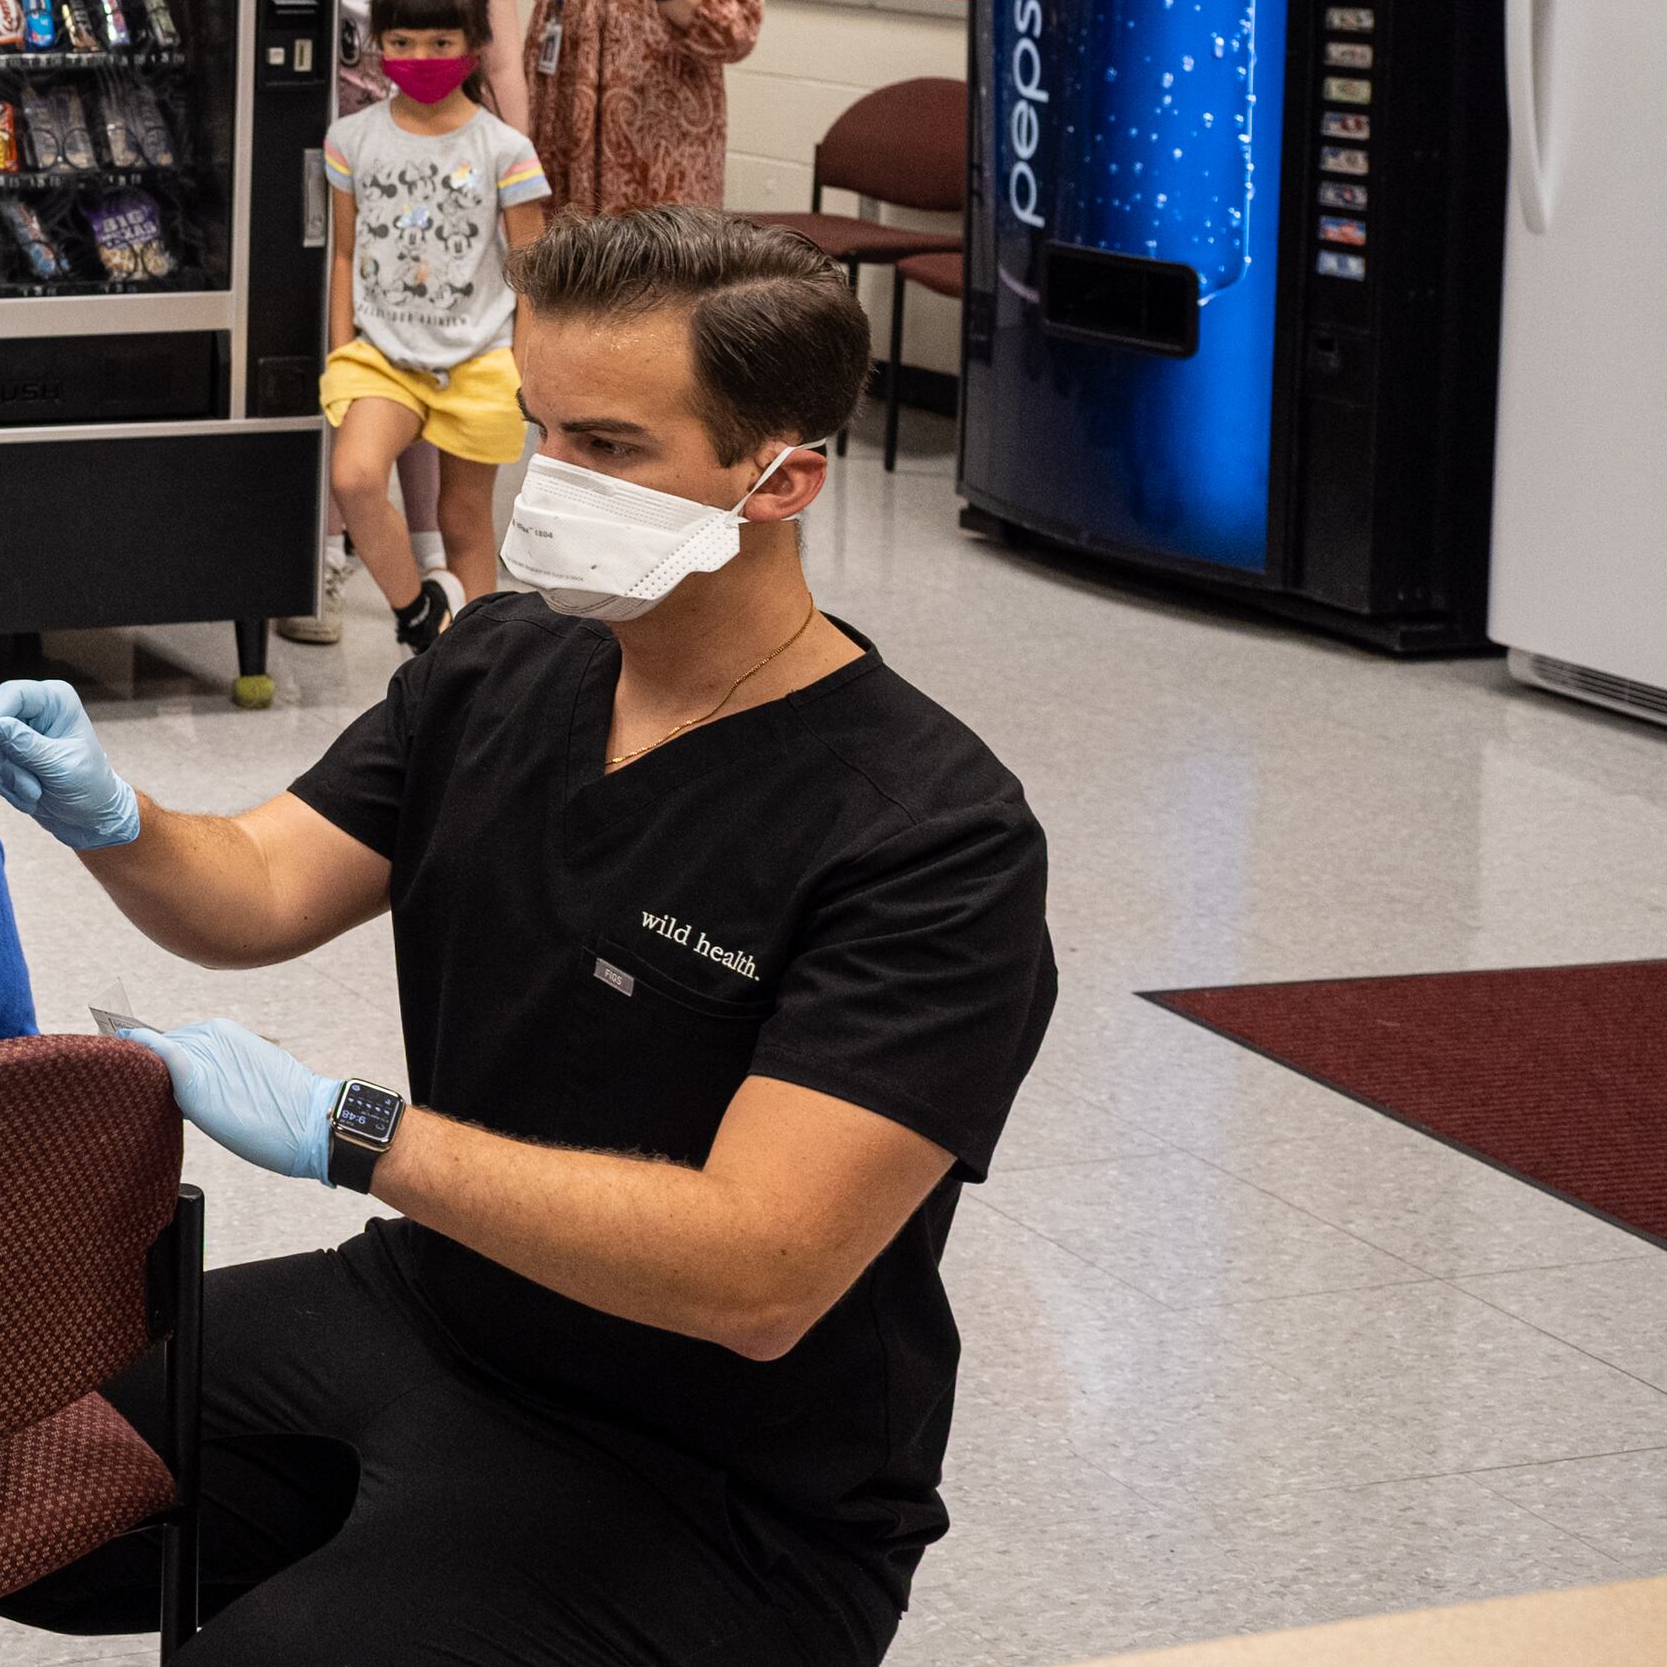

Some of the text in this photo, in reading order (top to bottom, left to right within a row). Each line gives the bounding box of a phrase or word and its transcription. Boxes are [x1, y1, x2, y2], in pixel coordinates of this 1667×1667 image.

[642, 911, 760, 982] wild health.
[604, 968, 622, 985] FIGS
